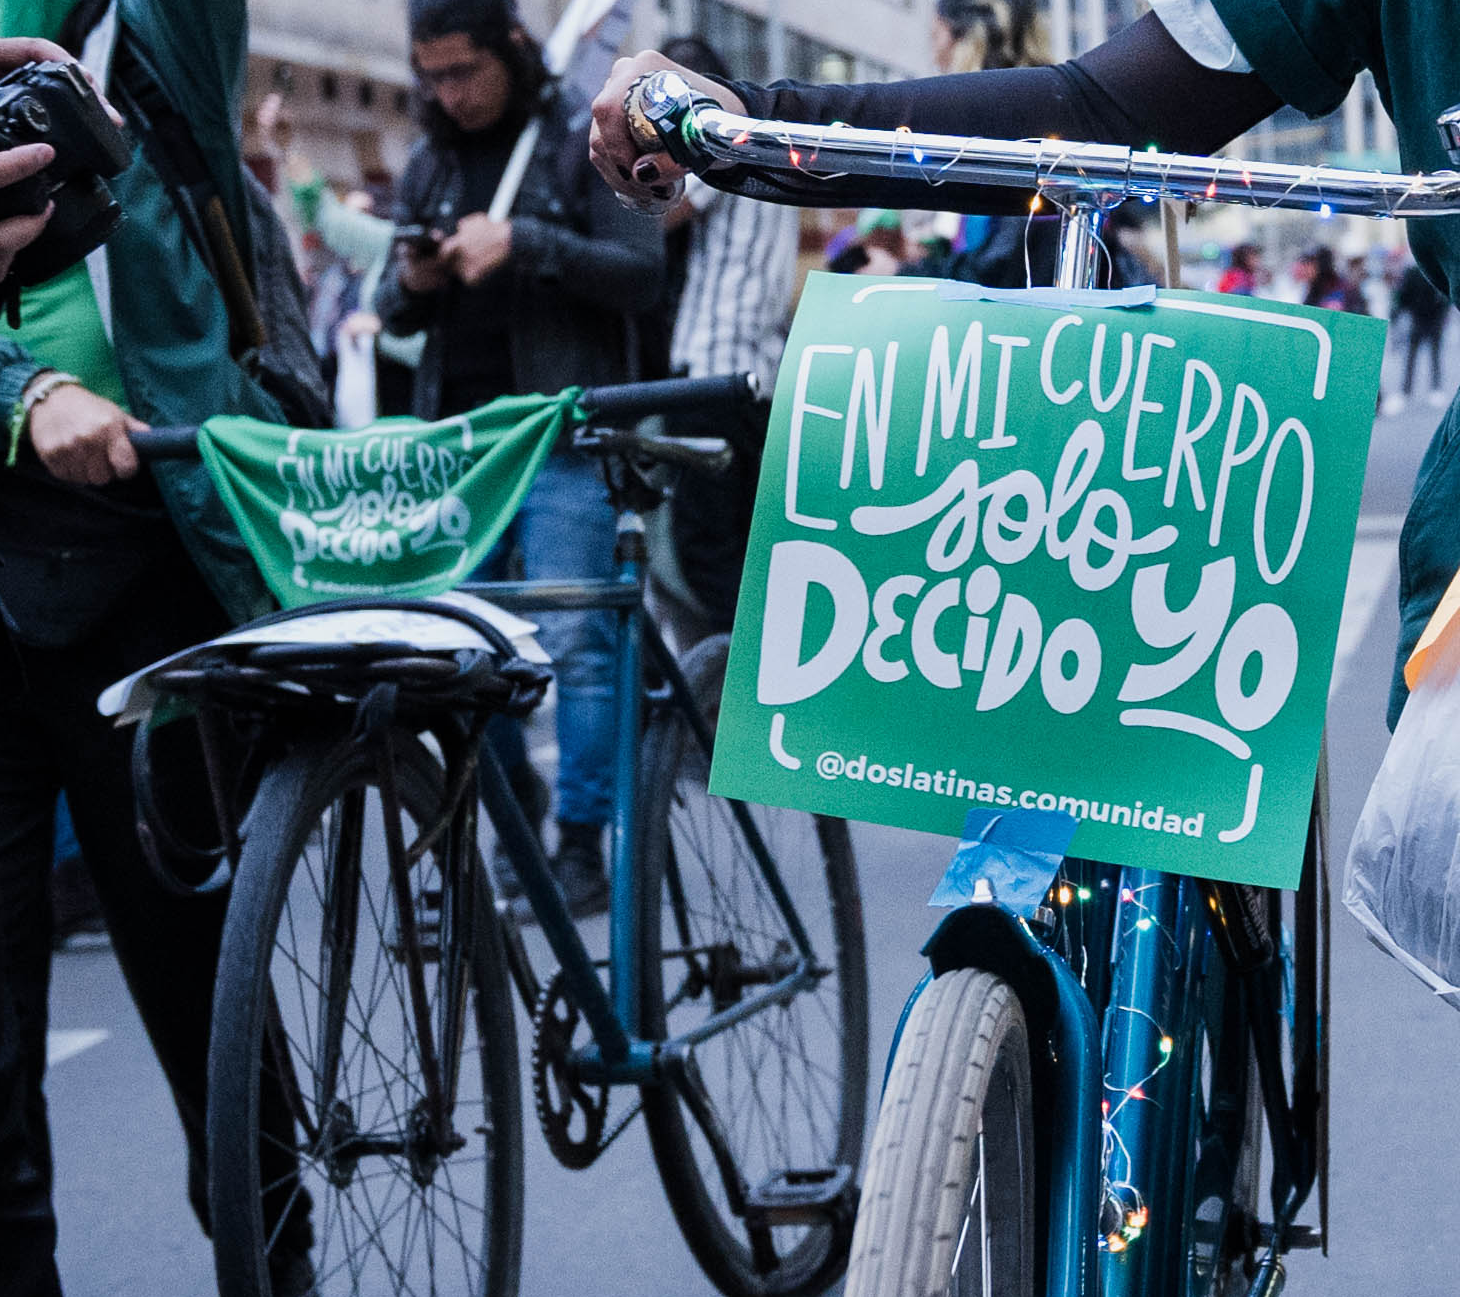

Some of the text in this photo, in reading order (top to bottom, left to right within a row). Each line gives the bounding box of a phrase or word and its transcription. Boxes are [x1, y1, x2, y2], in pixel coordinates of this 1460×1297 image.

[785, 314, 1315, 585] EN MI CUERPO
[849, 419, 1179, 592] solo
[815, 750, 1205, 838] @doslatinas.comunidad
